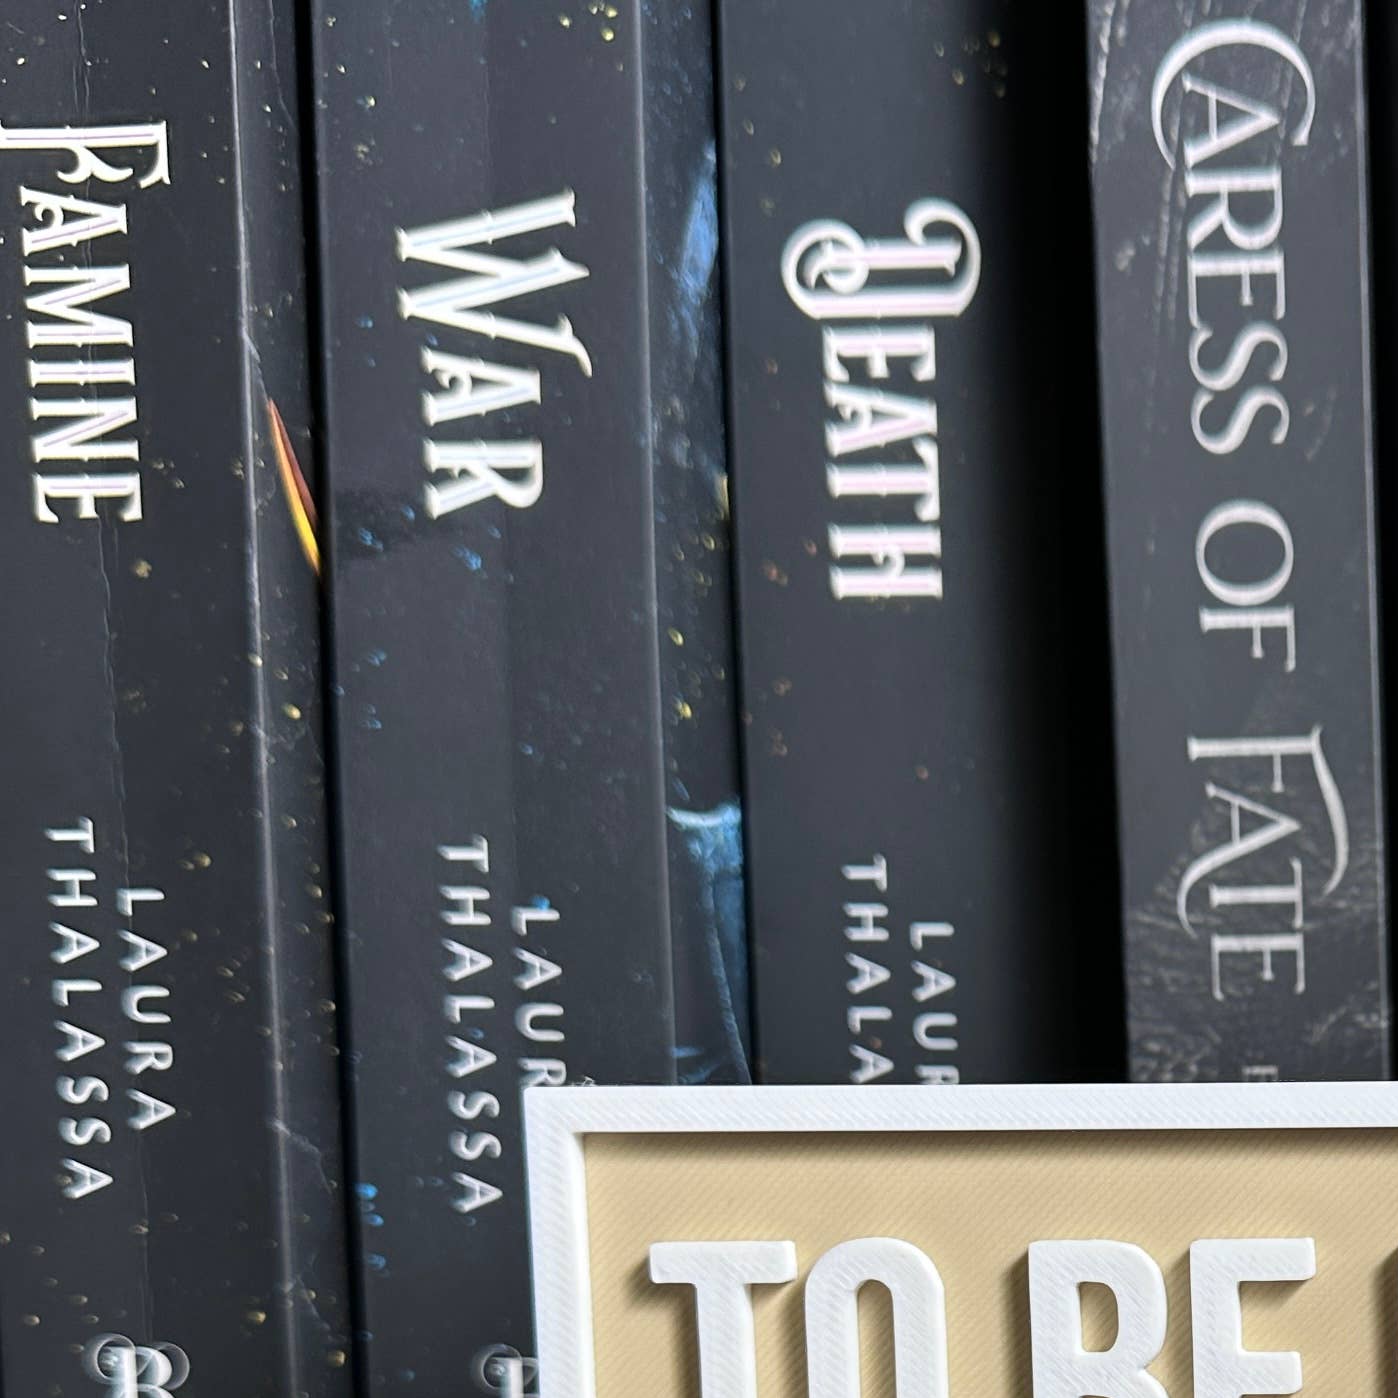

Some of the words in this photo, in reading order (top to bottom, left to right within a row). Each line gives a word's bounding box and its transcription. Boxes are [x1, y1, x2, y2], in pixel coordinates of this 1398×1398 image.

[0, 119, 171, 524] FAMINE
[395, 188, 594, 520] WAR
[781, 197, 982, 600] DEATH
[1152, 18, 1316, 455] CARESS
[1195, 499, 1296, 672] OF
[44, 816, 113, 1200] THALASSA
[116, 886, 176, 1130] LAURA
[437, 834, 503, 1213] THALASSA
[841, 853, 894, 1083] THALA
[1177, 725, 1349, 1001] FATE
